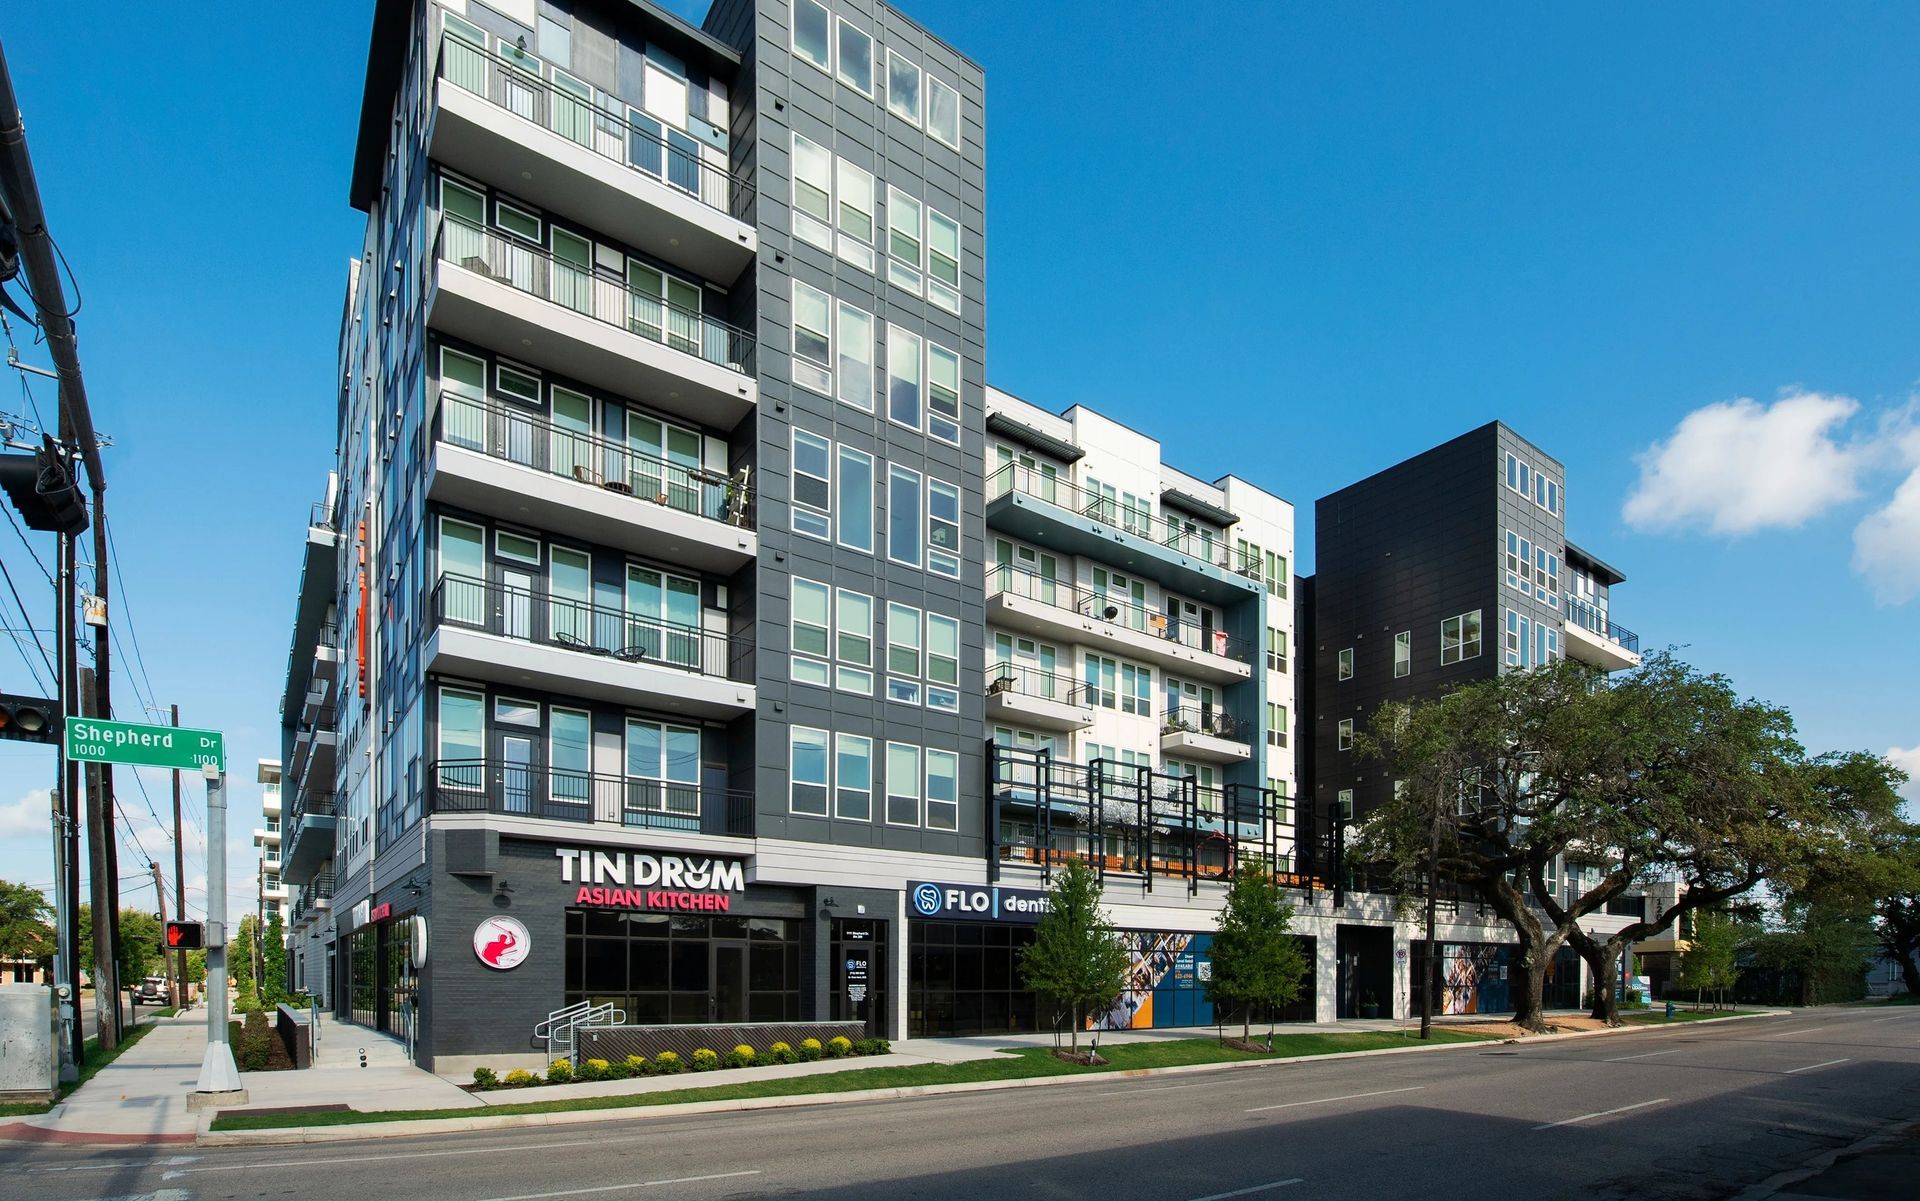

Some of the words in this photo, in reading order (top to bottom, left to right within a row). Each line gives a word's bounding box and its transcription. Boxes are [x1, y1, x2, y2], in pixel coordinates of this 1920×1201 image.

[74, 723, 173, 748] Shepherd
[200, 737, 217, 748] Dr
[74, 744, 105, 757] 1000
[555, 848, 626, 885] TIN
[634, 853, 745, 892] DRUM
[576, 886, 642, 909] ASIAN
[647, 890, 729, 912] KITCHEN
[944, 889, 990, 912] FLO
